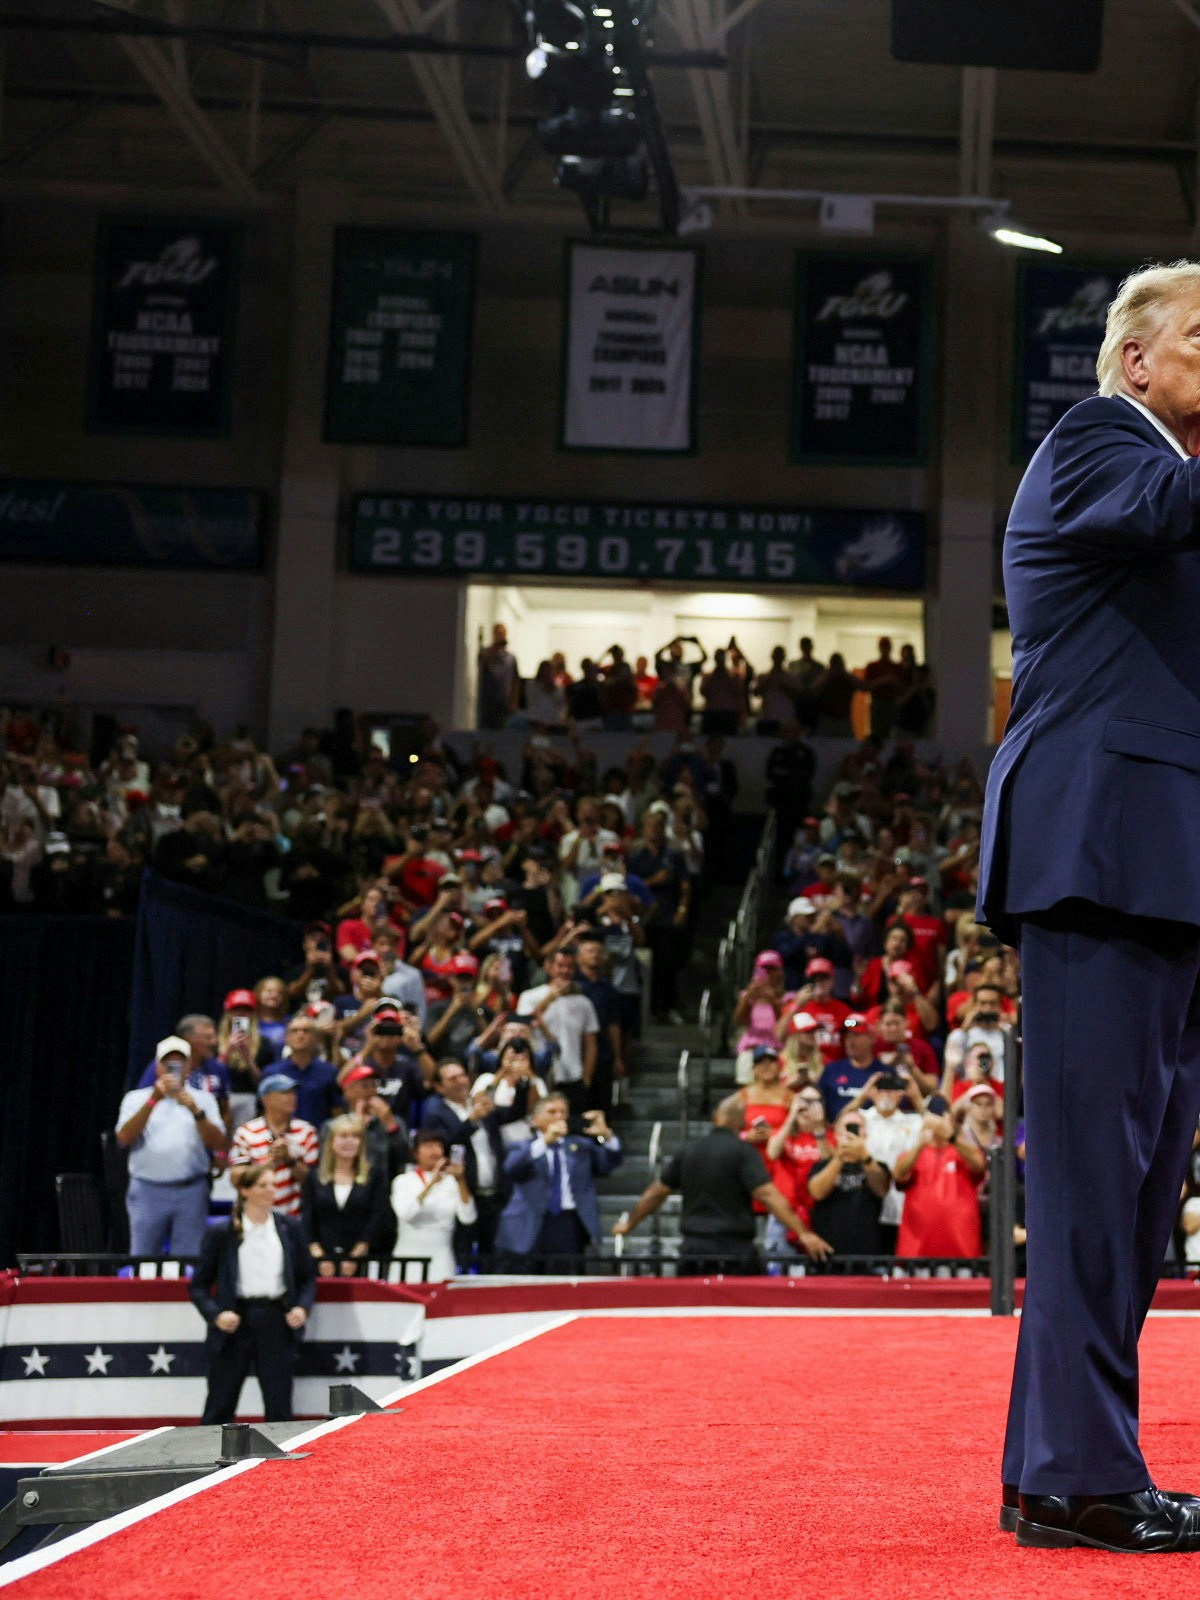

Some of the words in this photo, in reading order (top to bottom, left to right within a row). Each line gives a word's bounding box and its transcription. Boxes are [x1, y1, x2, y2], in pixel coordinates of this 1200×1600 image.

[1050, 355, 1098, 379] NCA
[358, 498, 415, 519] GET
[427, 500, 504, 523] YOUR
[604, 505, 727, 531] TICKETS
[738, 512, 812, 534] NOW!
[370, 526, 798, 579] 239.590.7145
